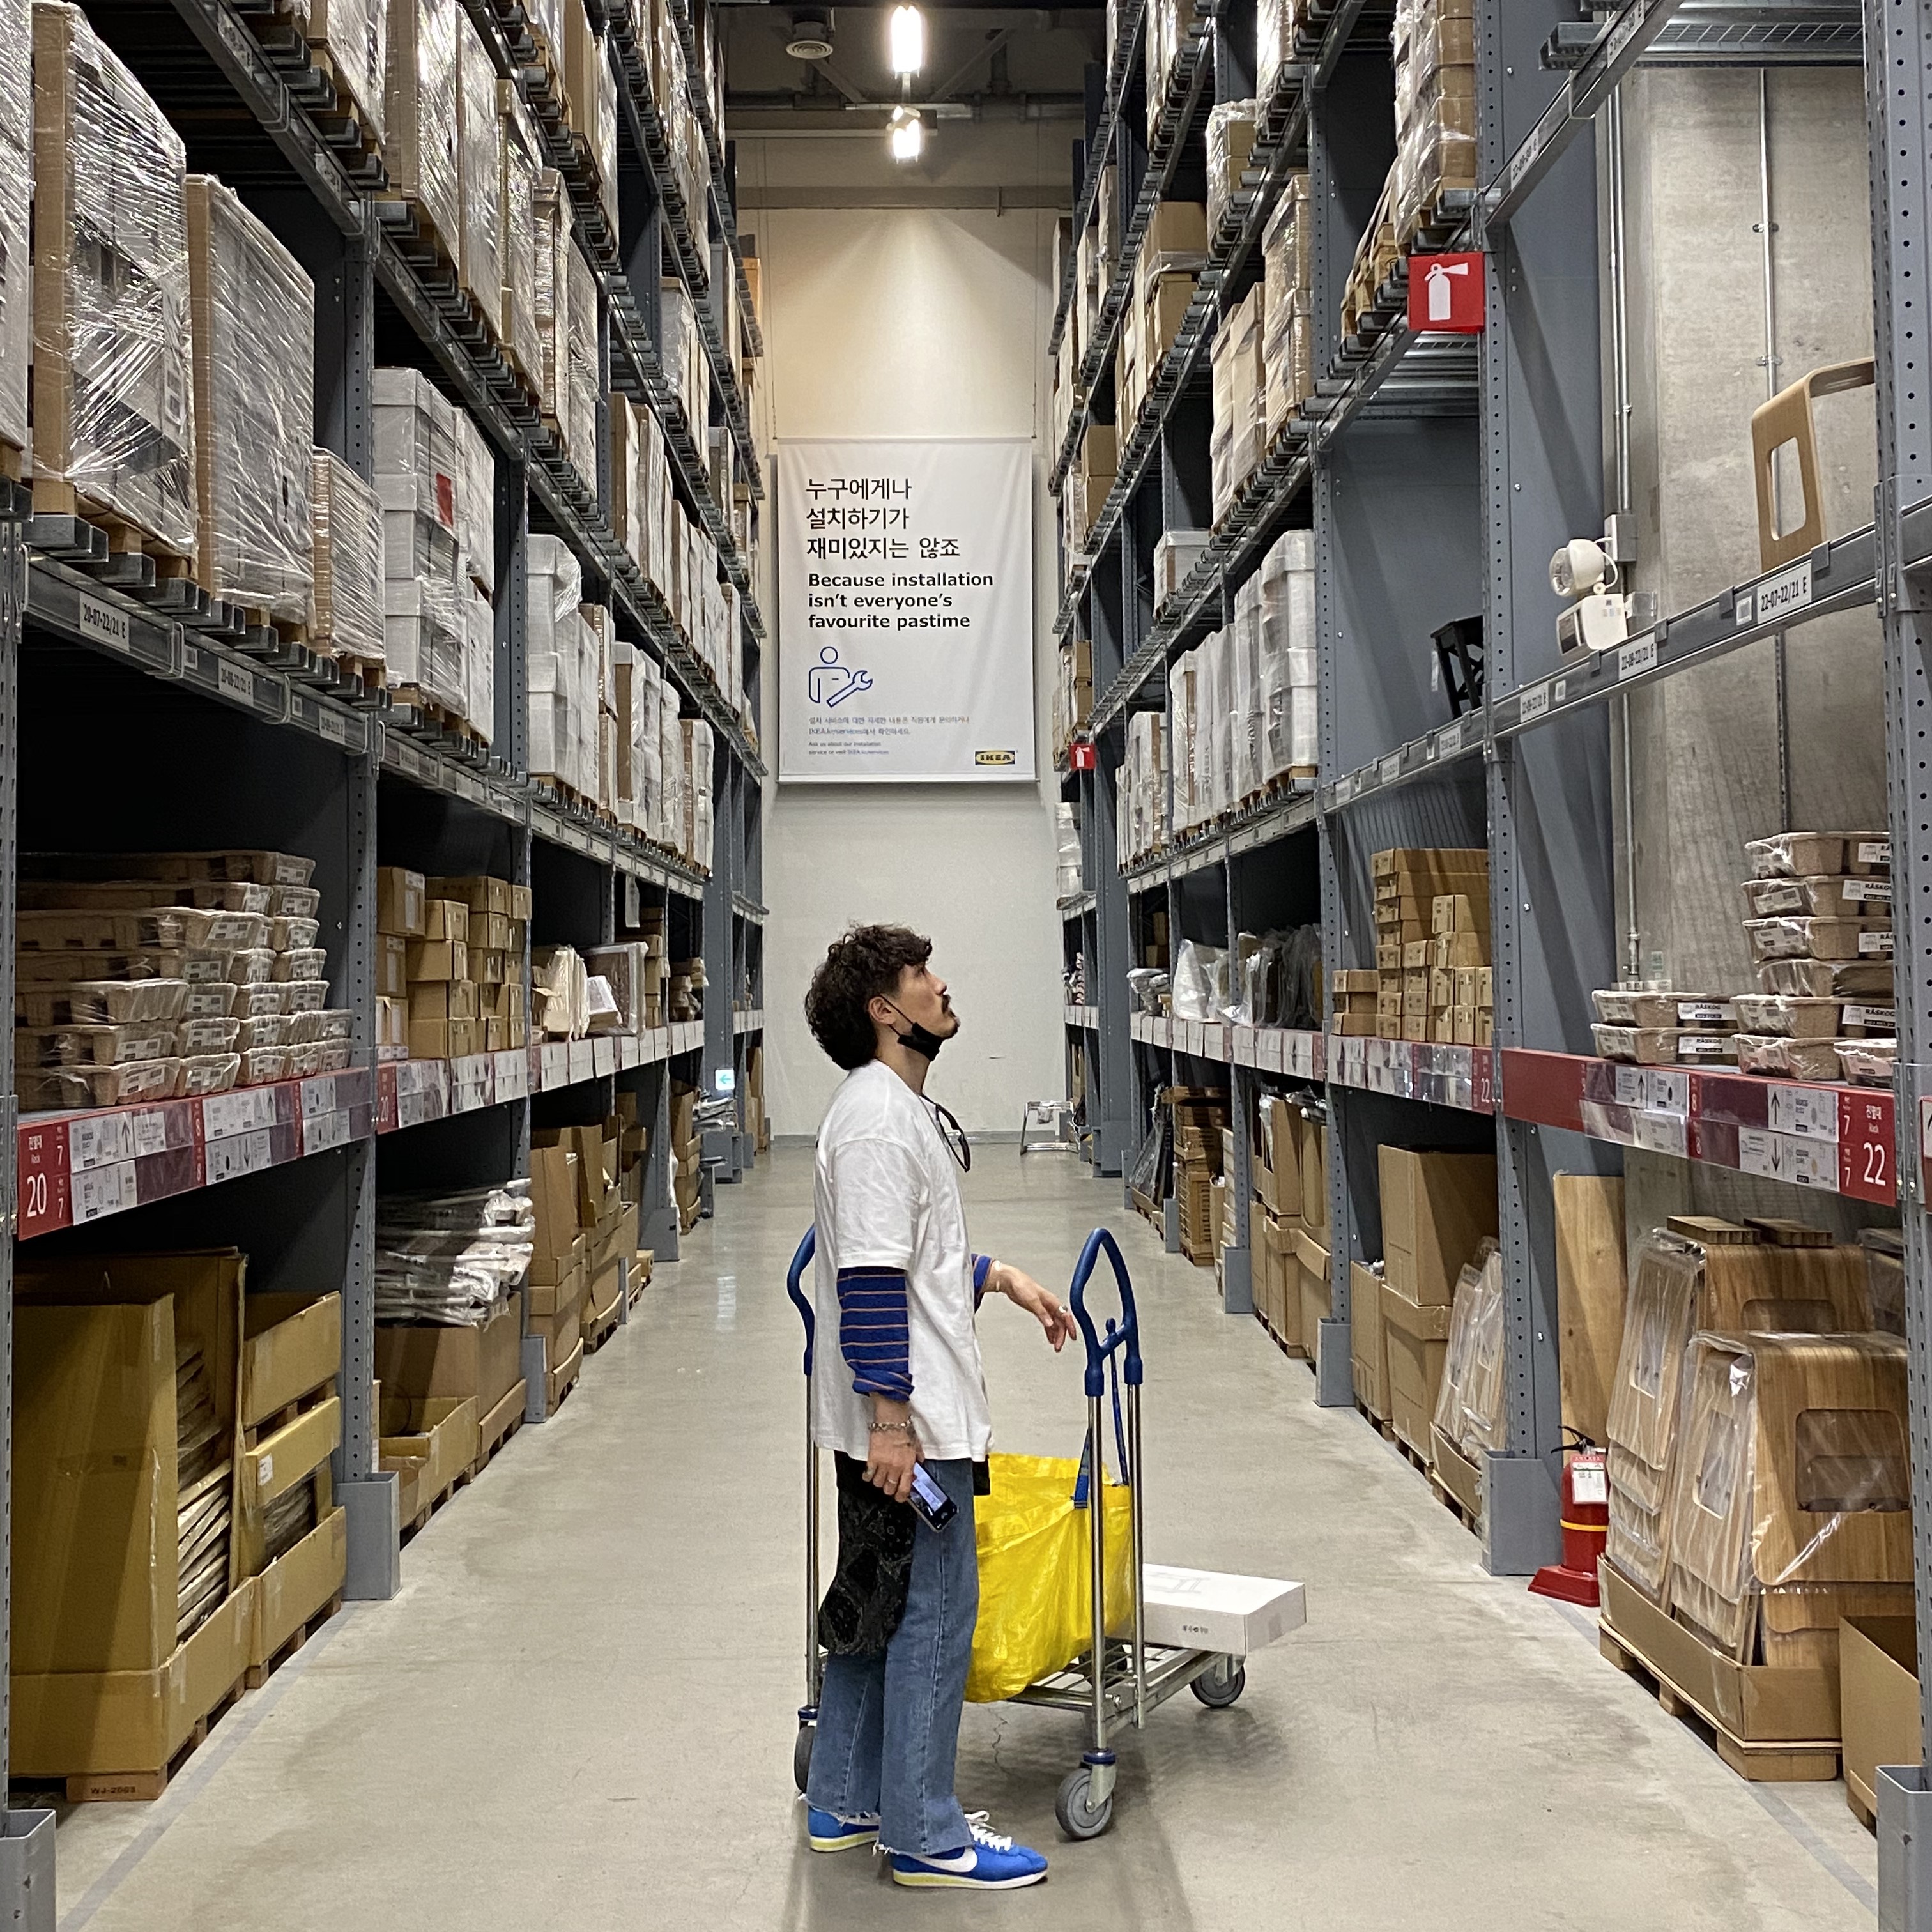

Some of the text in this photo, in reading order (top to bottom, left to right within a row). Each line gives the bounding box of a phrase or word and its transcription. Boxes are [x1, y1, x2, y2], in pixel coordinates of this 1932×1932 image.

[806, 478, 912, 500] 누구에게나
[806, 507, 909, 530] 설치하기가
[807, 537, 960, 560] 재미있지는 않죠
[808, 572, 993, 586] Because installation
[1803, 576, 1807, 594] E
[808, 593, 952, 610] isn't everyone's
[122, 621, 126, 638] E
[808, 613, 970, 631] favourite pastime
[1650, 643, 1654, 657] E
[1844, 1115, 1850, 1135] 7
[57, 1145, 63, 1165] 7
[1863, 1142, 1886, 1186] 22
[1845, 1167, 1851, 1188] 7
[26, 1172, 47, 1218] 20
[57, 1197, 64, 1218] 7
